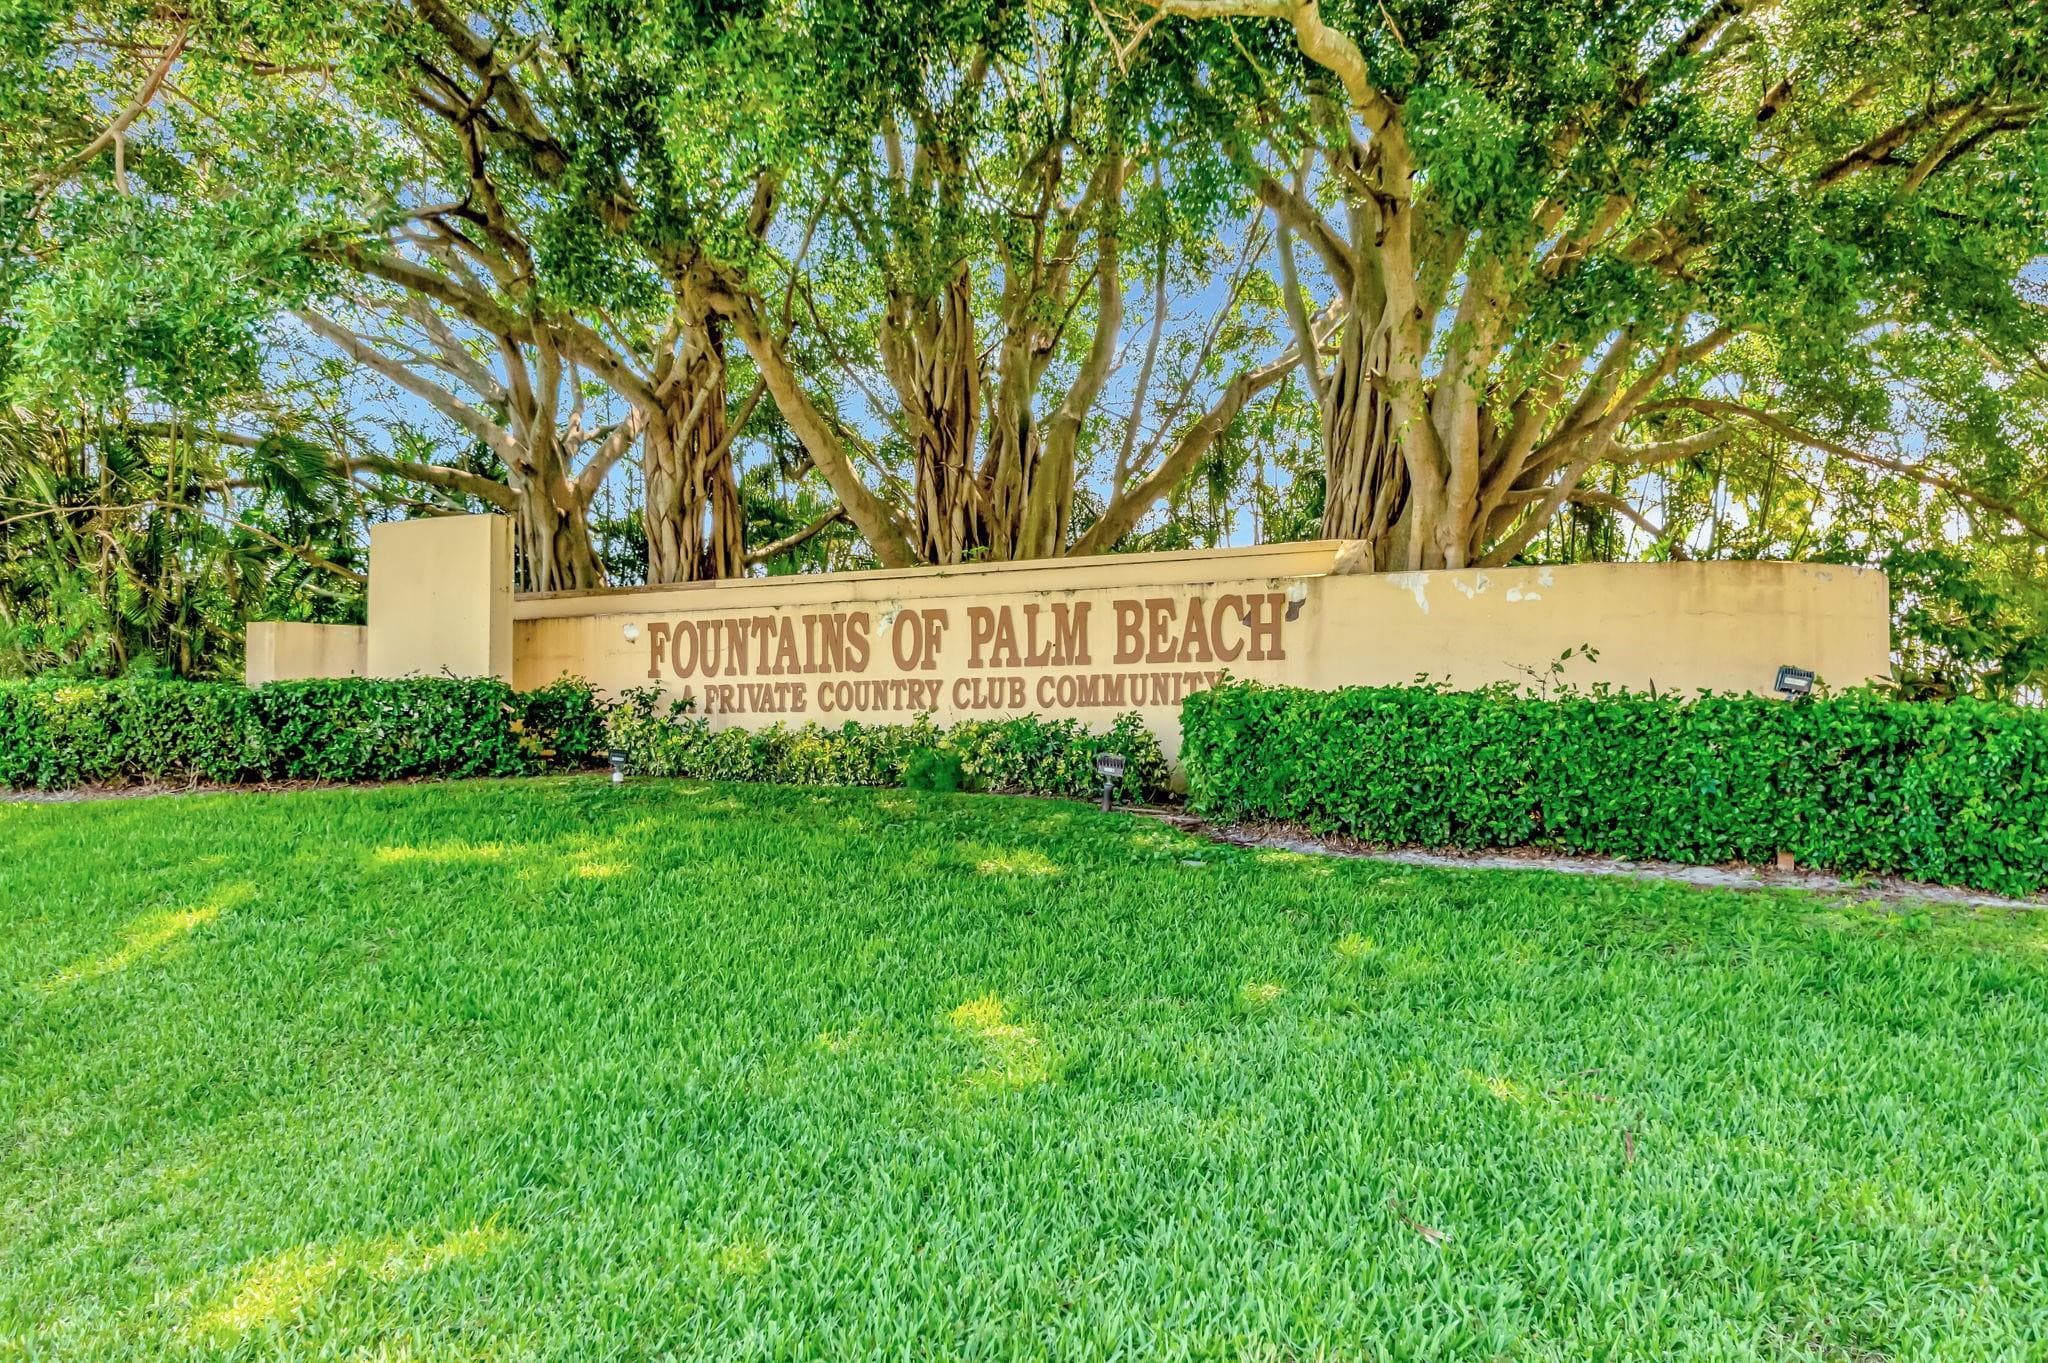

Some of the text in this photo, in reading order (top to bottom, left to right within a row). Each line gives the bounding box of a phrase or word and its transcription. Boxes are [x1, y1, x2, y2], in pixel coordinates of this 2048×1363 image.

[647, 593, 1286, 679] FOUNTAINS OF PALM BEACH
[703, 681, 807, 714] PRIVATE
[817, 678, 944, 712] COUNTRY
[952, 676, 1026, 709] CLUB
